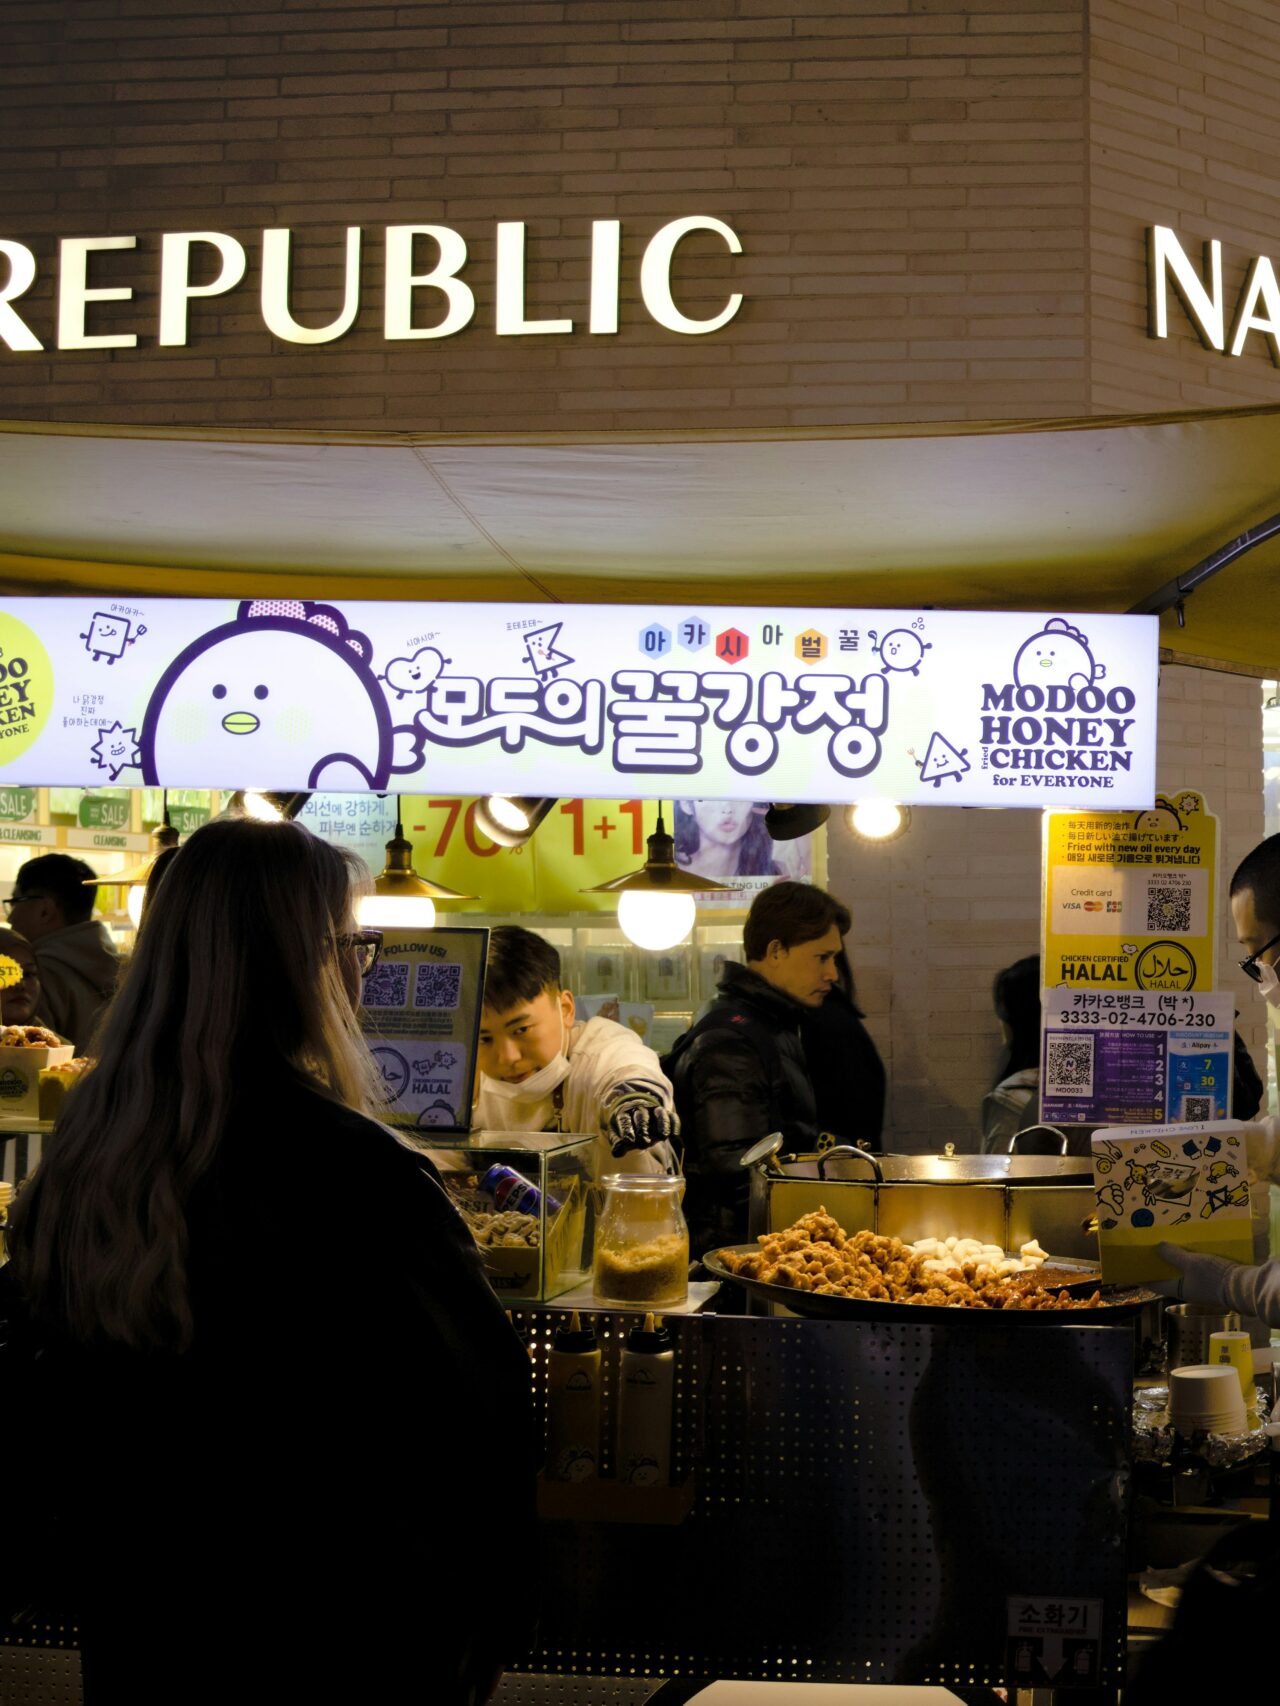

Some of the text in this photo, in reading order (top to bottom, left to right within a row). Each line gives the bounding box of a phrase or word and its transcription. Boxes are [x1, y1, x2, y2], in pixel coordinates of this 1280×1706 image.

[980, 683, 1136, 715] MODOO
[979, 715, 1136, 748] HONEY
[981, 746, 1133, 772] fried CHICKEN
[993, 773, 1115, 788] for EVERYONE
[0, 792, 27, 816] SALE
[300, 800, 342, 817] 외선에
[101, 803, 124, 825] SALE
[320, 821, 356, 836] 피부엔
[561, 798, 644, 856] 1+1
[93, 834, 127, 848] CLEANSING
[1067, 842, 1202, 856] Fried with new oil every day
[1067, 853, 1086, 863] 매일
[1087, 853, 1115, 863] 새로운
[1117, 853, 1153, 864] 기름으로
[755, 882, 770, 890] LIP
[1071, 888, 1113, 898] Credit card
[1062, 902, 1082, 911] VISA
[383, 943, 448, 959] FOLLOW US!
[1061, 955, 1129, 963] CHICKEN CERTIFIED
[1142, 953, 1190, 979] حلال
[1061, 963, 1128, 981] HALAL
[1149, 980, 1181, 989] HALAL
[1073, 994, 1146, 1010] 카카오뱅크
[1060, 1011, 1216, 1028] 3333-02-4706-230
[412, 1083, 451, 1095] HALAL
[1201, 1076, 1215, 1087] 30
[1154, 1108, 1163, 1120] 5
[1018, 1602, 1089, 1629] 소화기
